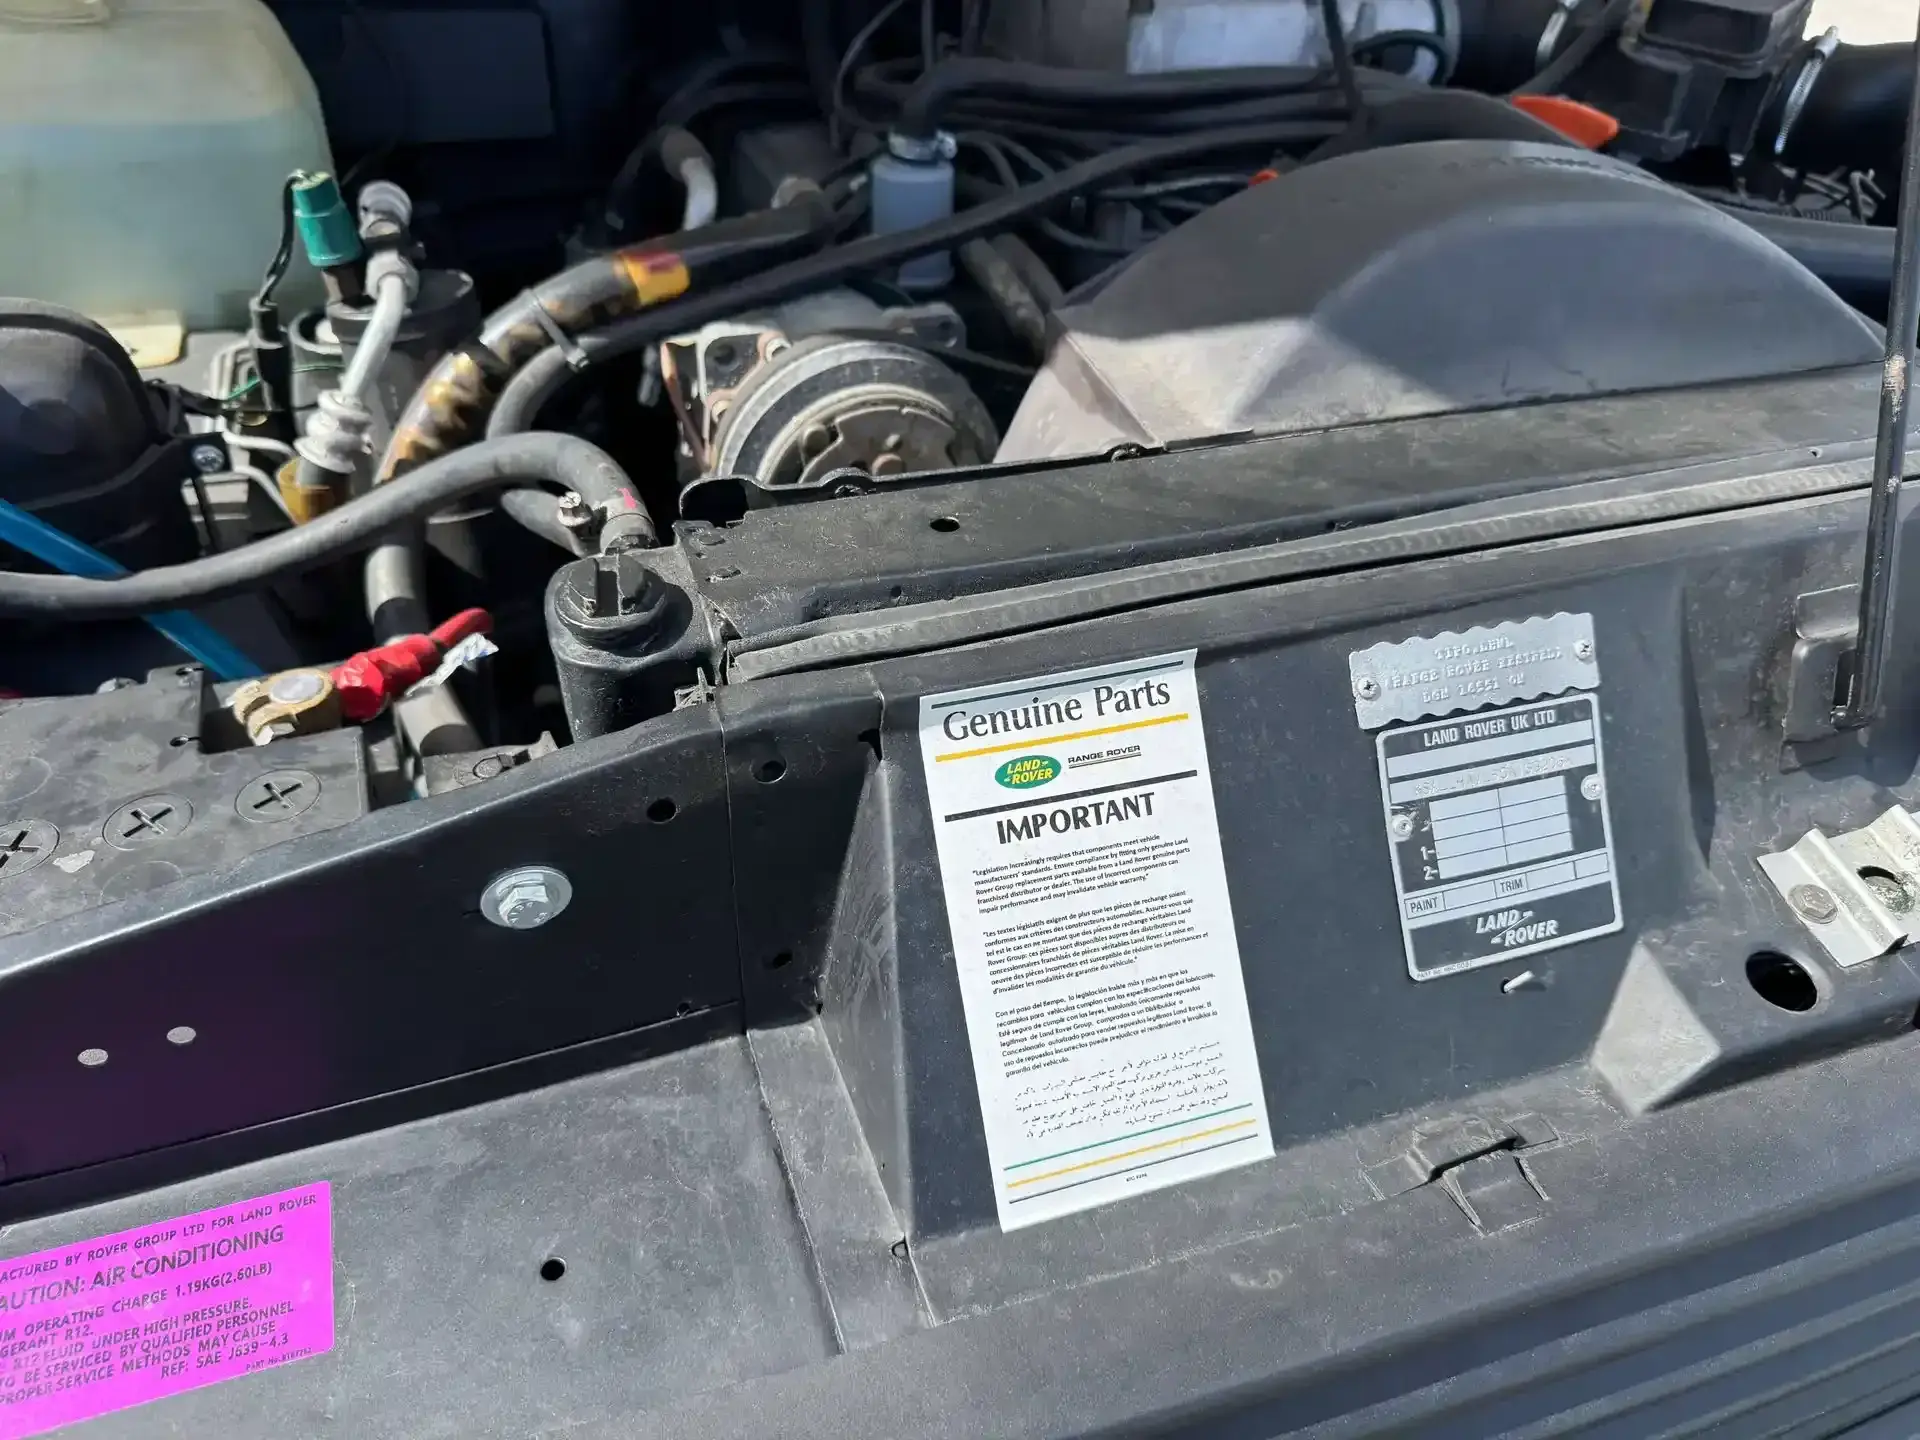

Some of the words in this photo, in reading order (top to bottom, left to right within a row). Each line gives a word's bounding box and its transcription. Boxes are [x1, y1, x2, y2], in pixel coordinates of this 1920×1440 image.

[943, 696, 1083, 741] Genuine
[1094, 680, 1171, 717] Parts
[1424, 728, 1460, 748] LAND
[1465, 718, 1506, 740] ROVER
[1510, 712, 1529, 733] UK
[1534, 708, 1557, 727] LTD
[1006, 758, 1040, 775] LAND
[1011, 767, 1054, 786] ROVER
[1068, 751, 1104, 765] RANGE
[1106, 744, 1141, 758] ROVER
[996, 792, 1156, 845] IMPORTANT
[1410, 898, 1438, 914] PAINT
[1499, 879, 1524, 894] TRIM
[1476, 909, 1521, 934] LAND
[1504, 919, 1560, 947] ROVER
[64, 1251, 82, 1267] BY
[87, 1240, 128, 1261] ROVER
[134, 1228, 177, 1249] GROUP
[182, 1221, 205, 1237] LTD
[211, 1213, 234, 1230] FOR
[240, 1204, 273, 1223] LAND
[278, 1193, 316, 1213] ROVER
[88, 1263, 125, 1290] AIR
[130, 1223, 284, 1279] CONDITIONING
[23, 1303, 105, 1336] OPERATING
[111, 1287, 167, 1314] CHARGE
[64, 1322, 94, 1342] R12.
[91, 1325, 140, 1350] UNDER
[143, 1315, 178, 1336] HIGH
[182, 1295, 253, 1326] PRESSURE.
[23, 1366, 41, 1383] BE
[43, 1347, 112, 1378] SERVICED
[119, 1341, 136, 1358] BY
[140, 1321, 212, 1353] QUALIFIED
[215, 1299, 294, 1333] PERSONNEL
[55, 1363, 114, 1391] SERVICE
[120, 1342, 191, 1374] METHODS
[197, 1332, 230, 1353] MAY
[232, 1319, 276, 1344] CAUSE
[161, 1361, 188, 1379] REF:
[196, 1352, 222, 1369] SAE
[228, 1333, 289, 1360] J639-4.3
